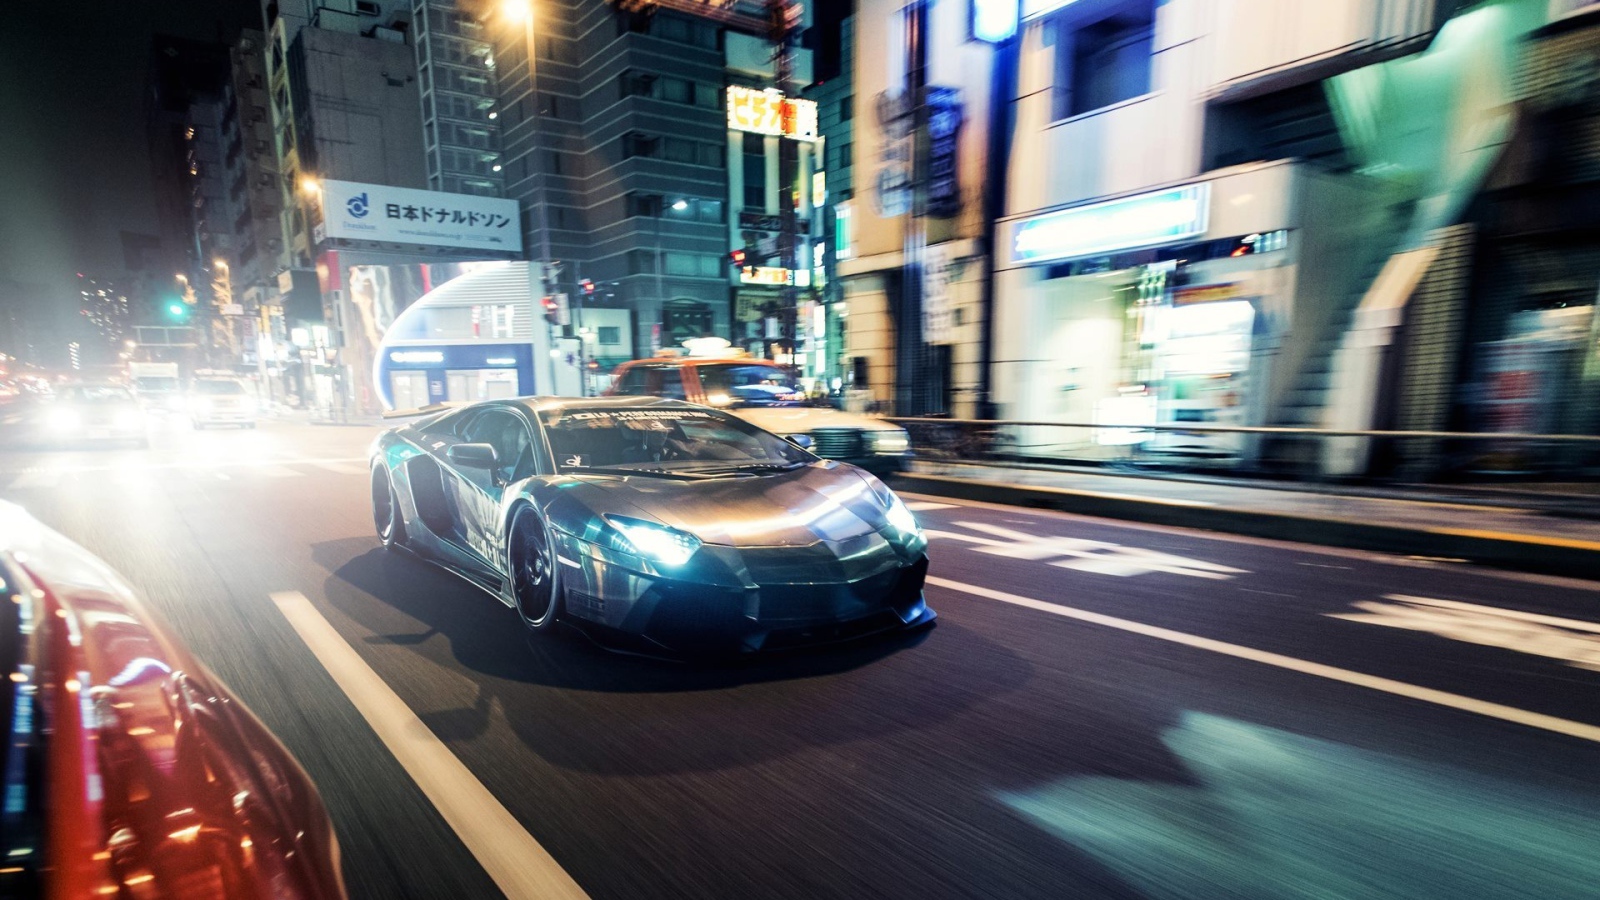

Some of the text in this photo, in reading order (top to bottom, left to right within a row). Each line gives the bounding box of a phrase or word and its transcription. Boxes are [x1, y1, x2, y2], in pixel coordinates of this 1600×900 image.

[385, 203, 510, 228] 日本ドナルドソン
